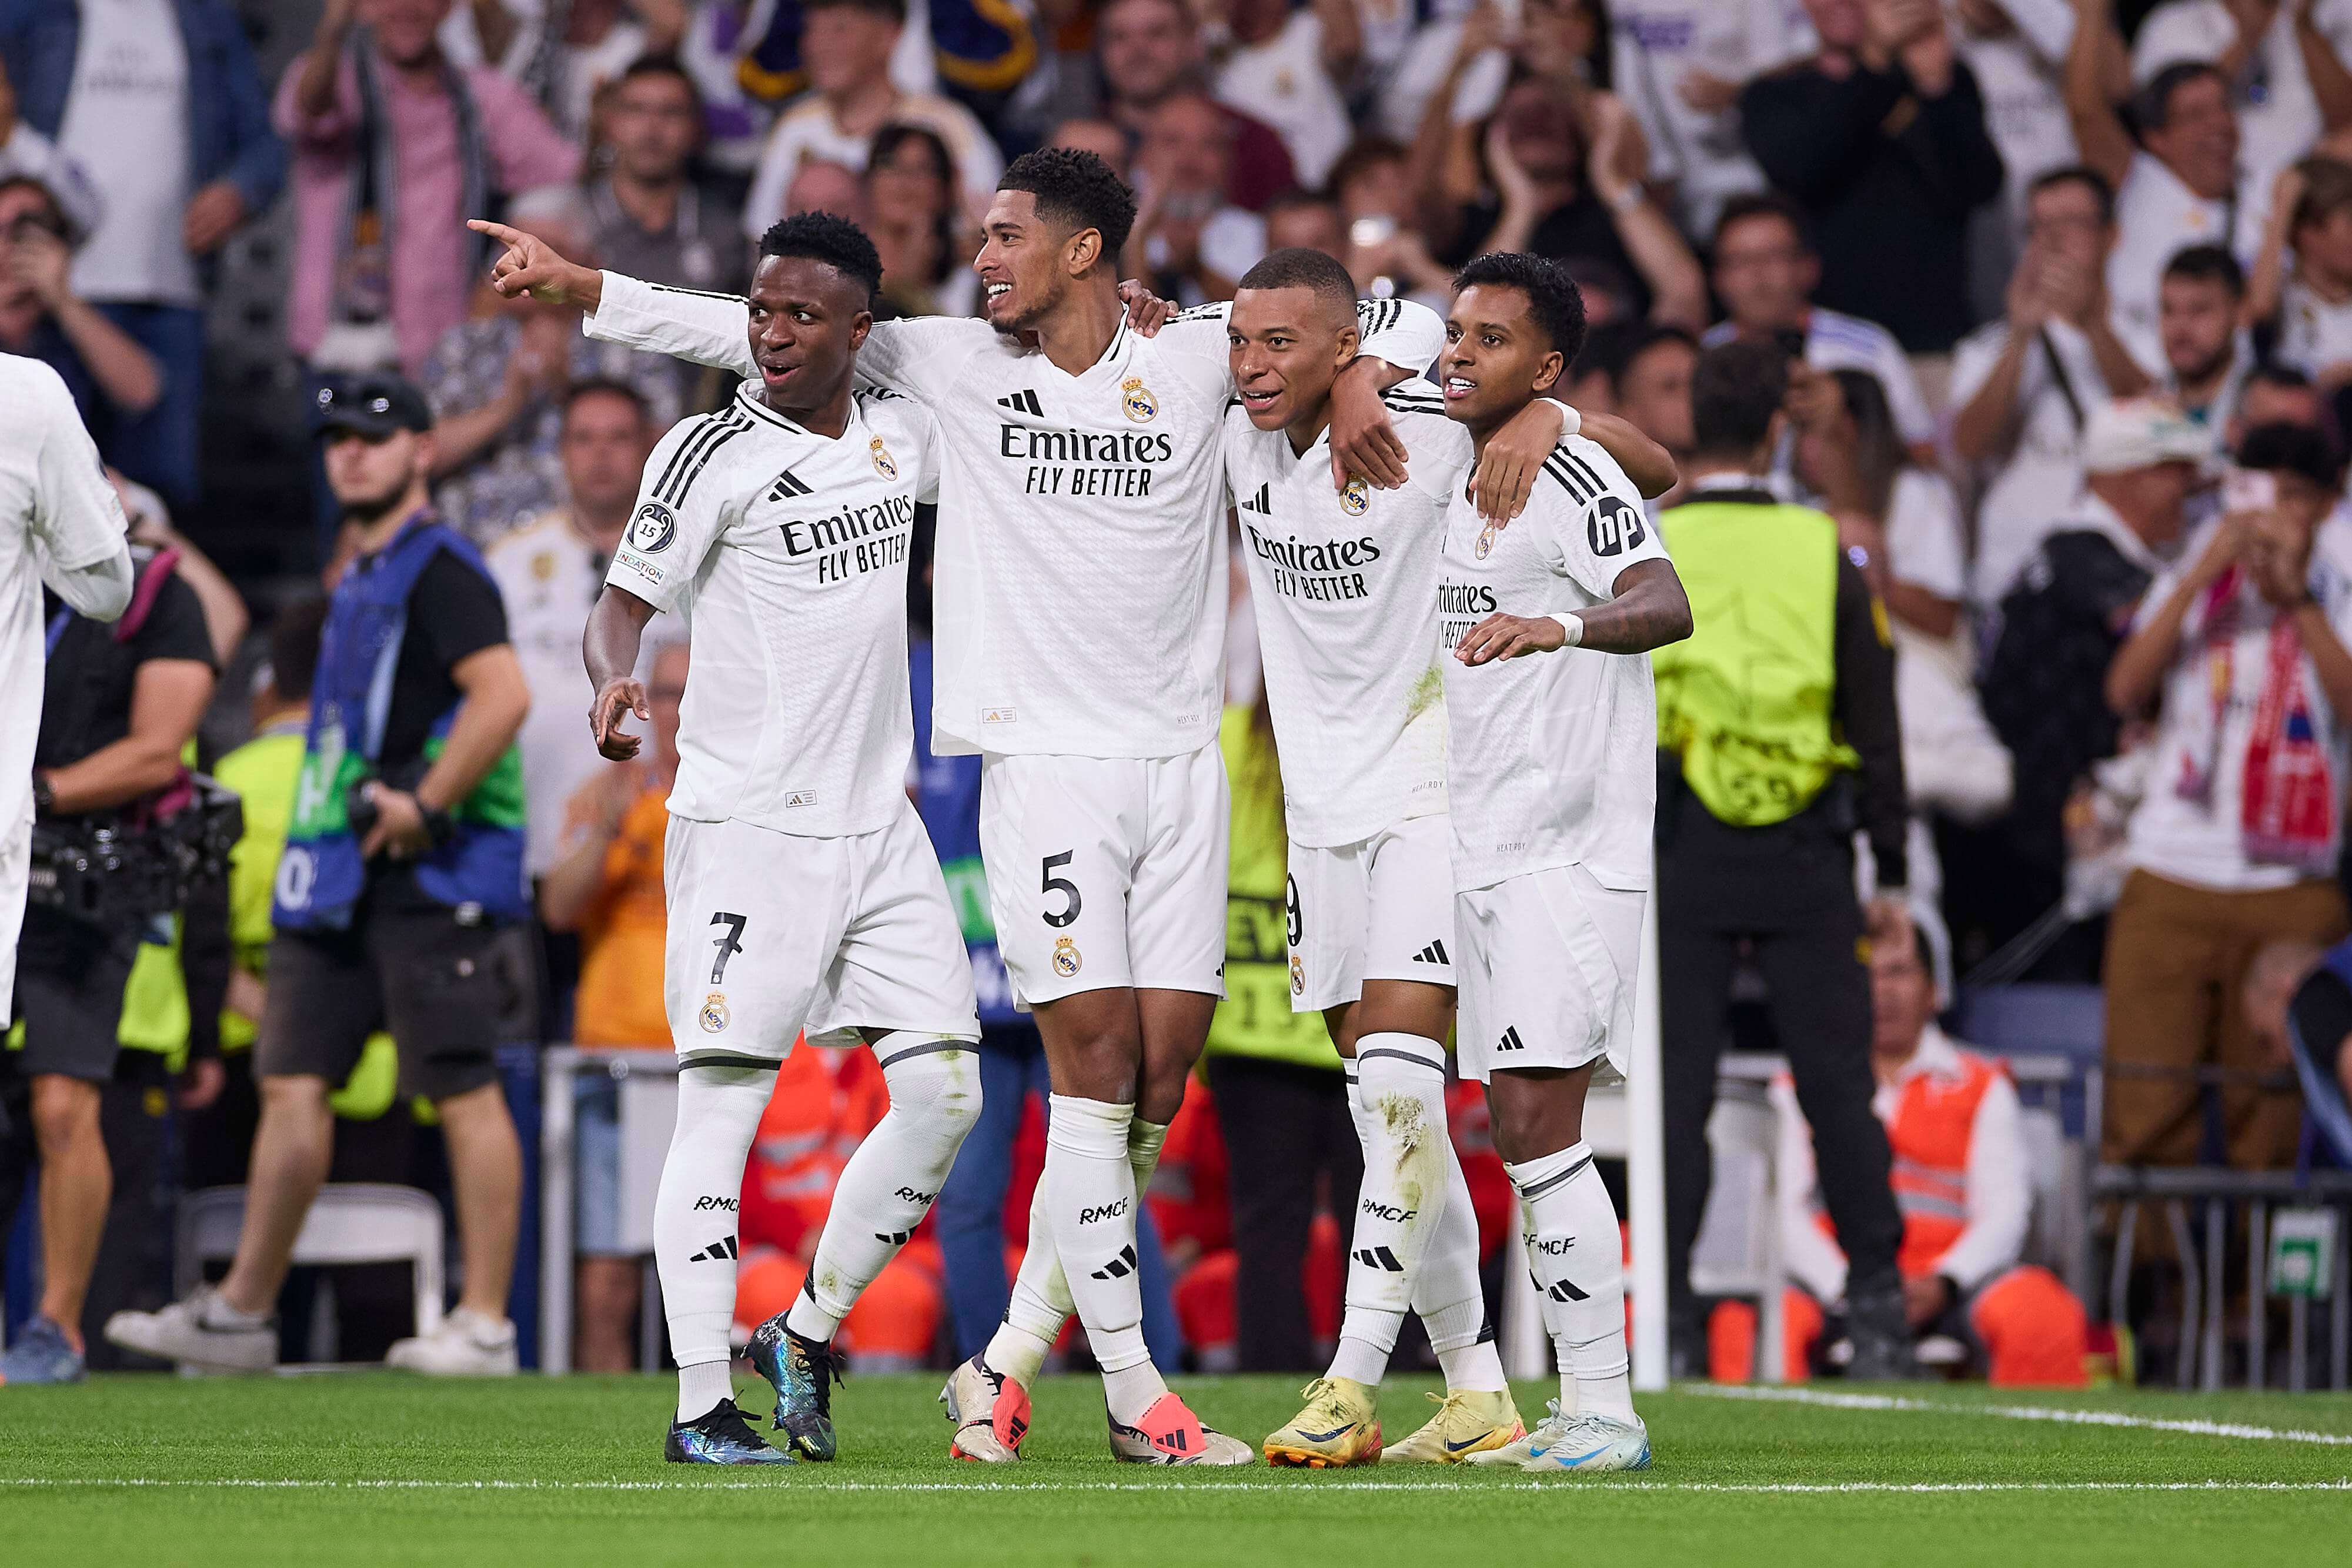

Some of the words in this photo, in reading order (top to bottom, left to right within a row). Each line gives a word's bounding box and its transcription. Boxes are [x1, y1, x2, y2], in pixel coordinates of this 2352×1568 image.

[1001, 424, 1172, 463] Emirates
[1025, 466, 1064, 494] FLY
[1071, 468, 1152, 497] BETTER
[639, 523, 657, 537] 15
[779, 494, 912, 557] Emirates
[1588, 497, 1645, 556] hp
[819, 549, 848, 584] FLY
[856, 533, 906, 573] BETTER
[1247, 524, 1381, 571] Emirates
[1274, 568, 1297, 597] FLY
[1300, 573, 1369, 601] BETTER
[1438, 576, 1497, 614] mirates
[1042, 848, 1081, 928] 5
[1286, 872, 1302, 947] 9
[709, 912, 747, 984] 7
[1079, 1196, 1128, 1225] RMCF
[1362, 1199, 1418, 1223] RMCF
